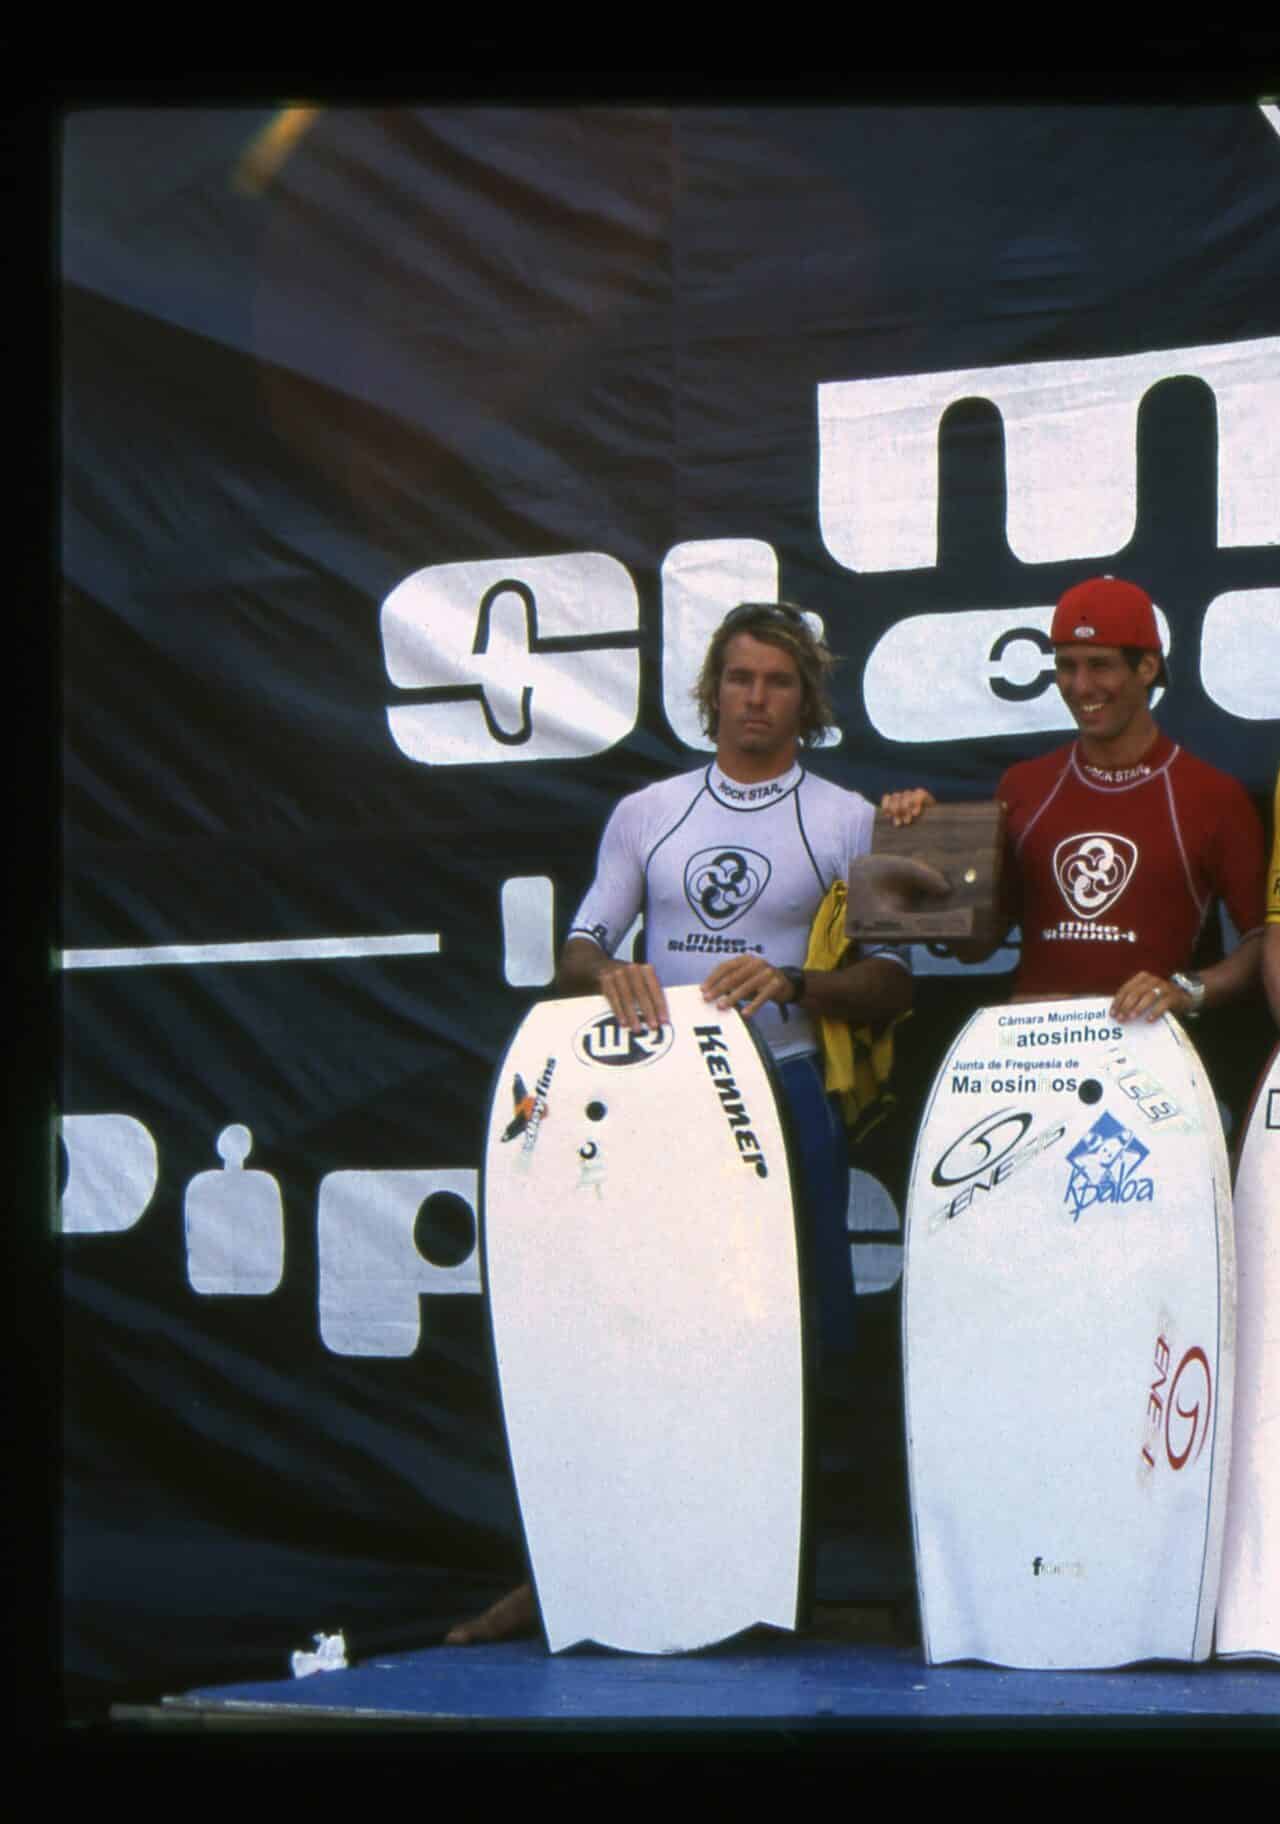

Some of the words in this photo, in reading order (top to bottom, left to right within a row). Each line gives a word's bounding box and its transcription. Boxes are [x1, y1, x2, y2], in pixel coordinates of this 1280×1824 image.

[1048, 1008, 1106, 1023] Municipal
[1005, 1025, 1123, 1048] atosinhos
[953, 1060, 984, 1071] Junta
[988, 1059, 1002, 1070] de
[1006, 1059, 1061, 1072] Freguesia
[1065, 1058, 1079, 1069] de
[952, 1074, 1078, 1094] Maosinos
